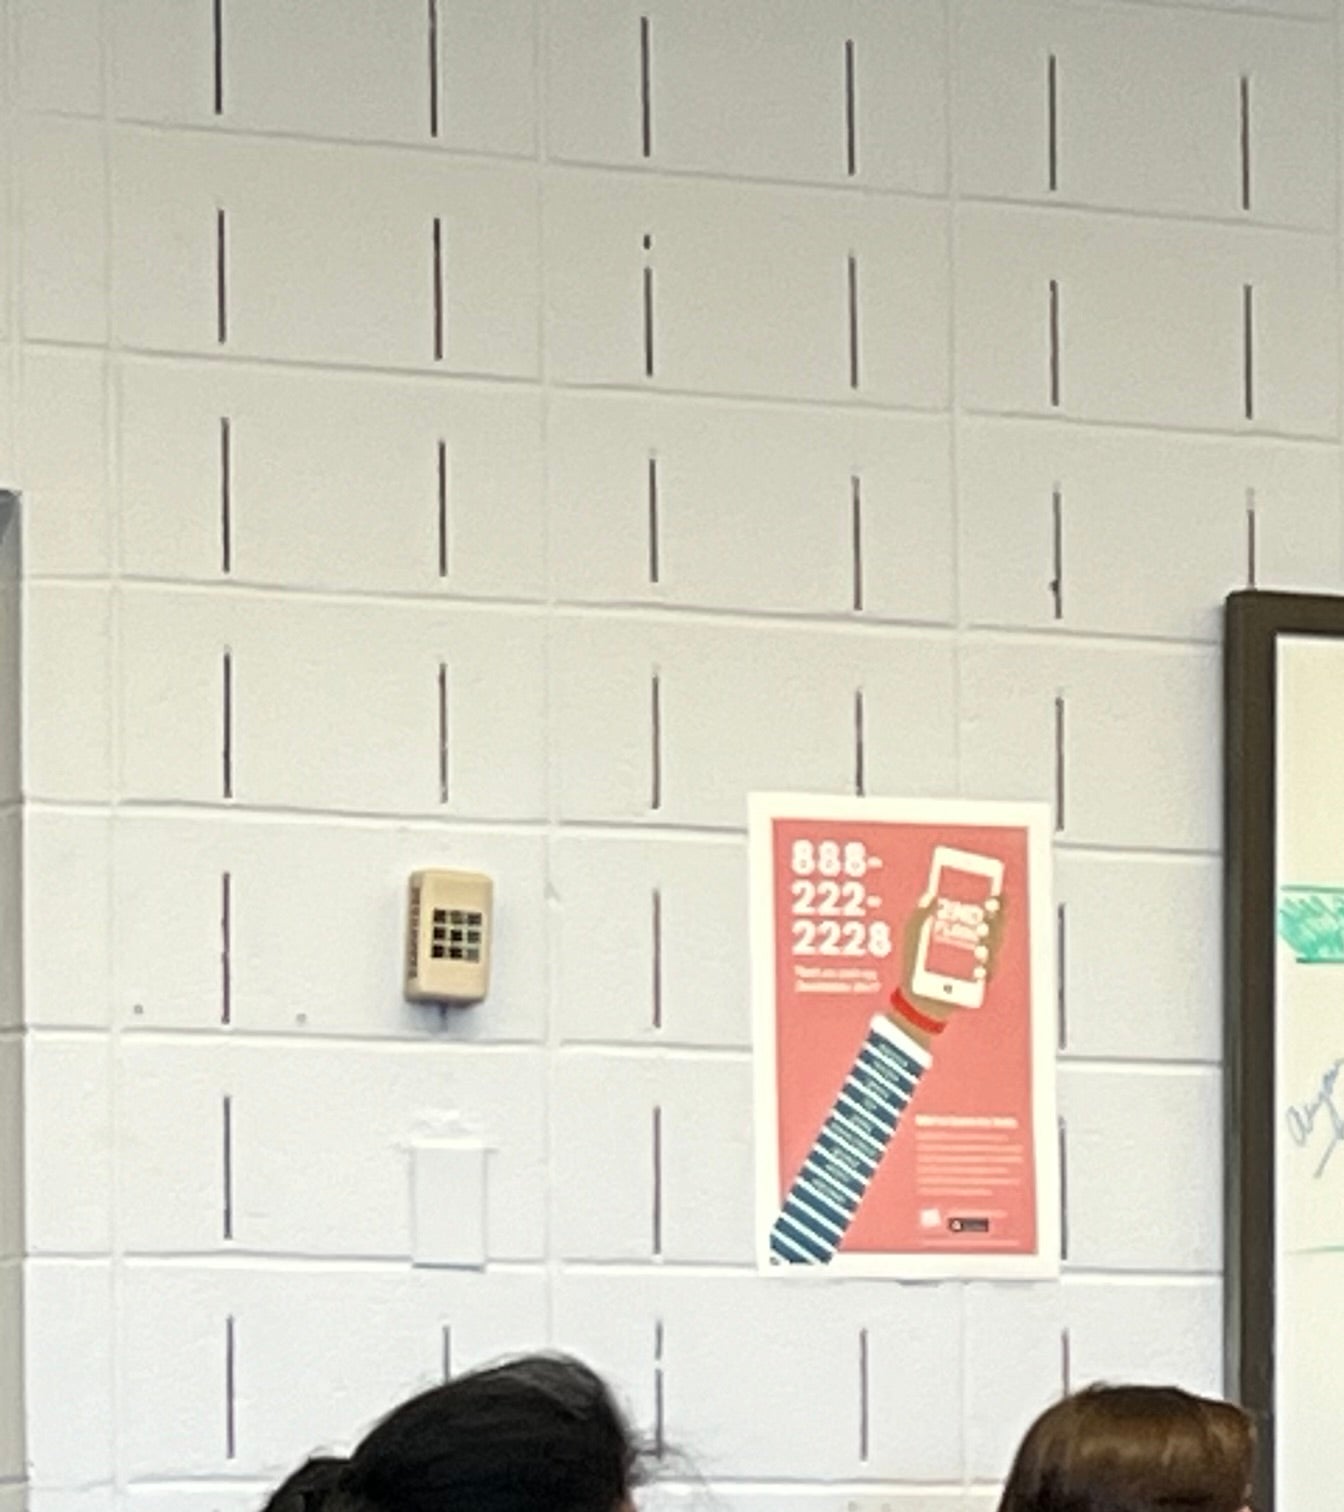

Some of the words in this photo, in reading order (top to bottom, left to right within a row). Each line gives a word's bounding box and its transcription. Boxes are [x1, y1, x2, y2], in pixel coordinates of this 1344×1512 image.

[791, 839, 884, 878] 888-
[791, 878, 884, 917] 222-
[791, 918, 893, 959] 2228
